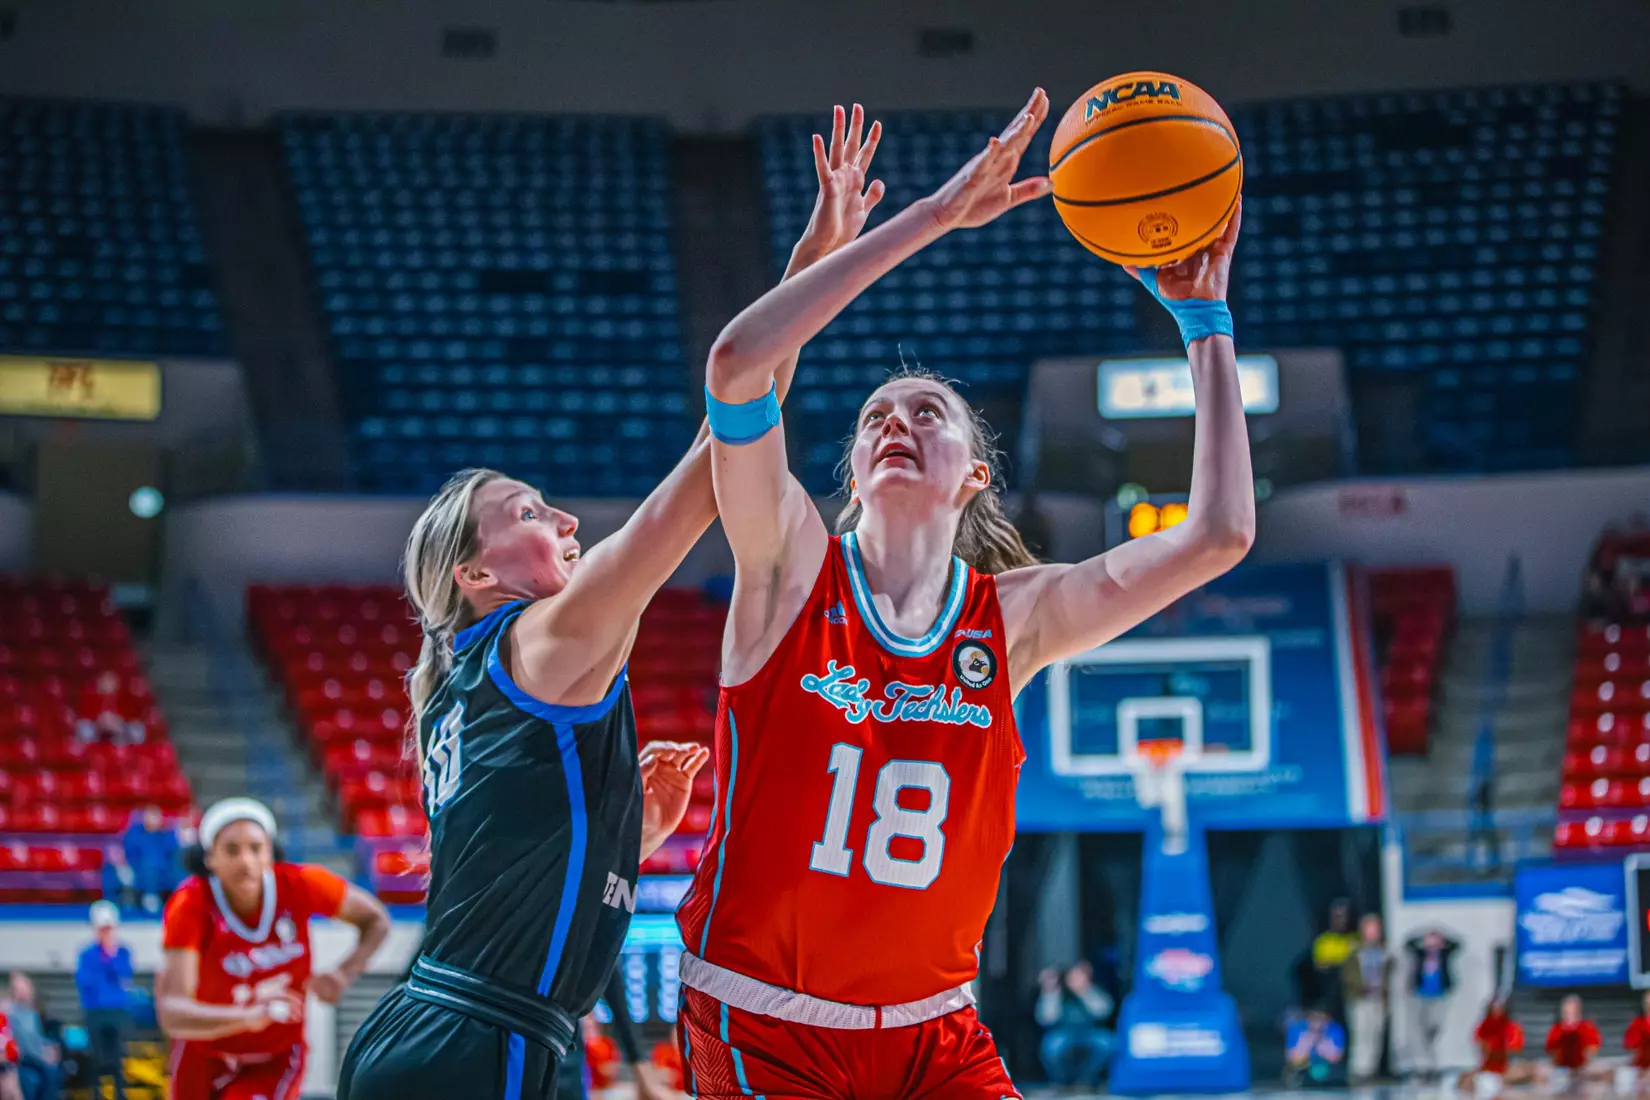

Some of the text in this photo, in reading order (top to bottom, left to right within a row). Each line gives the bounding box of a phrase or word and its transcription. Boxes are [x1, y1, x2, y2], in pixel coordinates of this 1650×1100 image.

[1085, 81, 1181, 121] NCAA
[800, 659, 992, 728] Lady Techsters
[809, 742, 951, 890] 18
